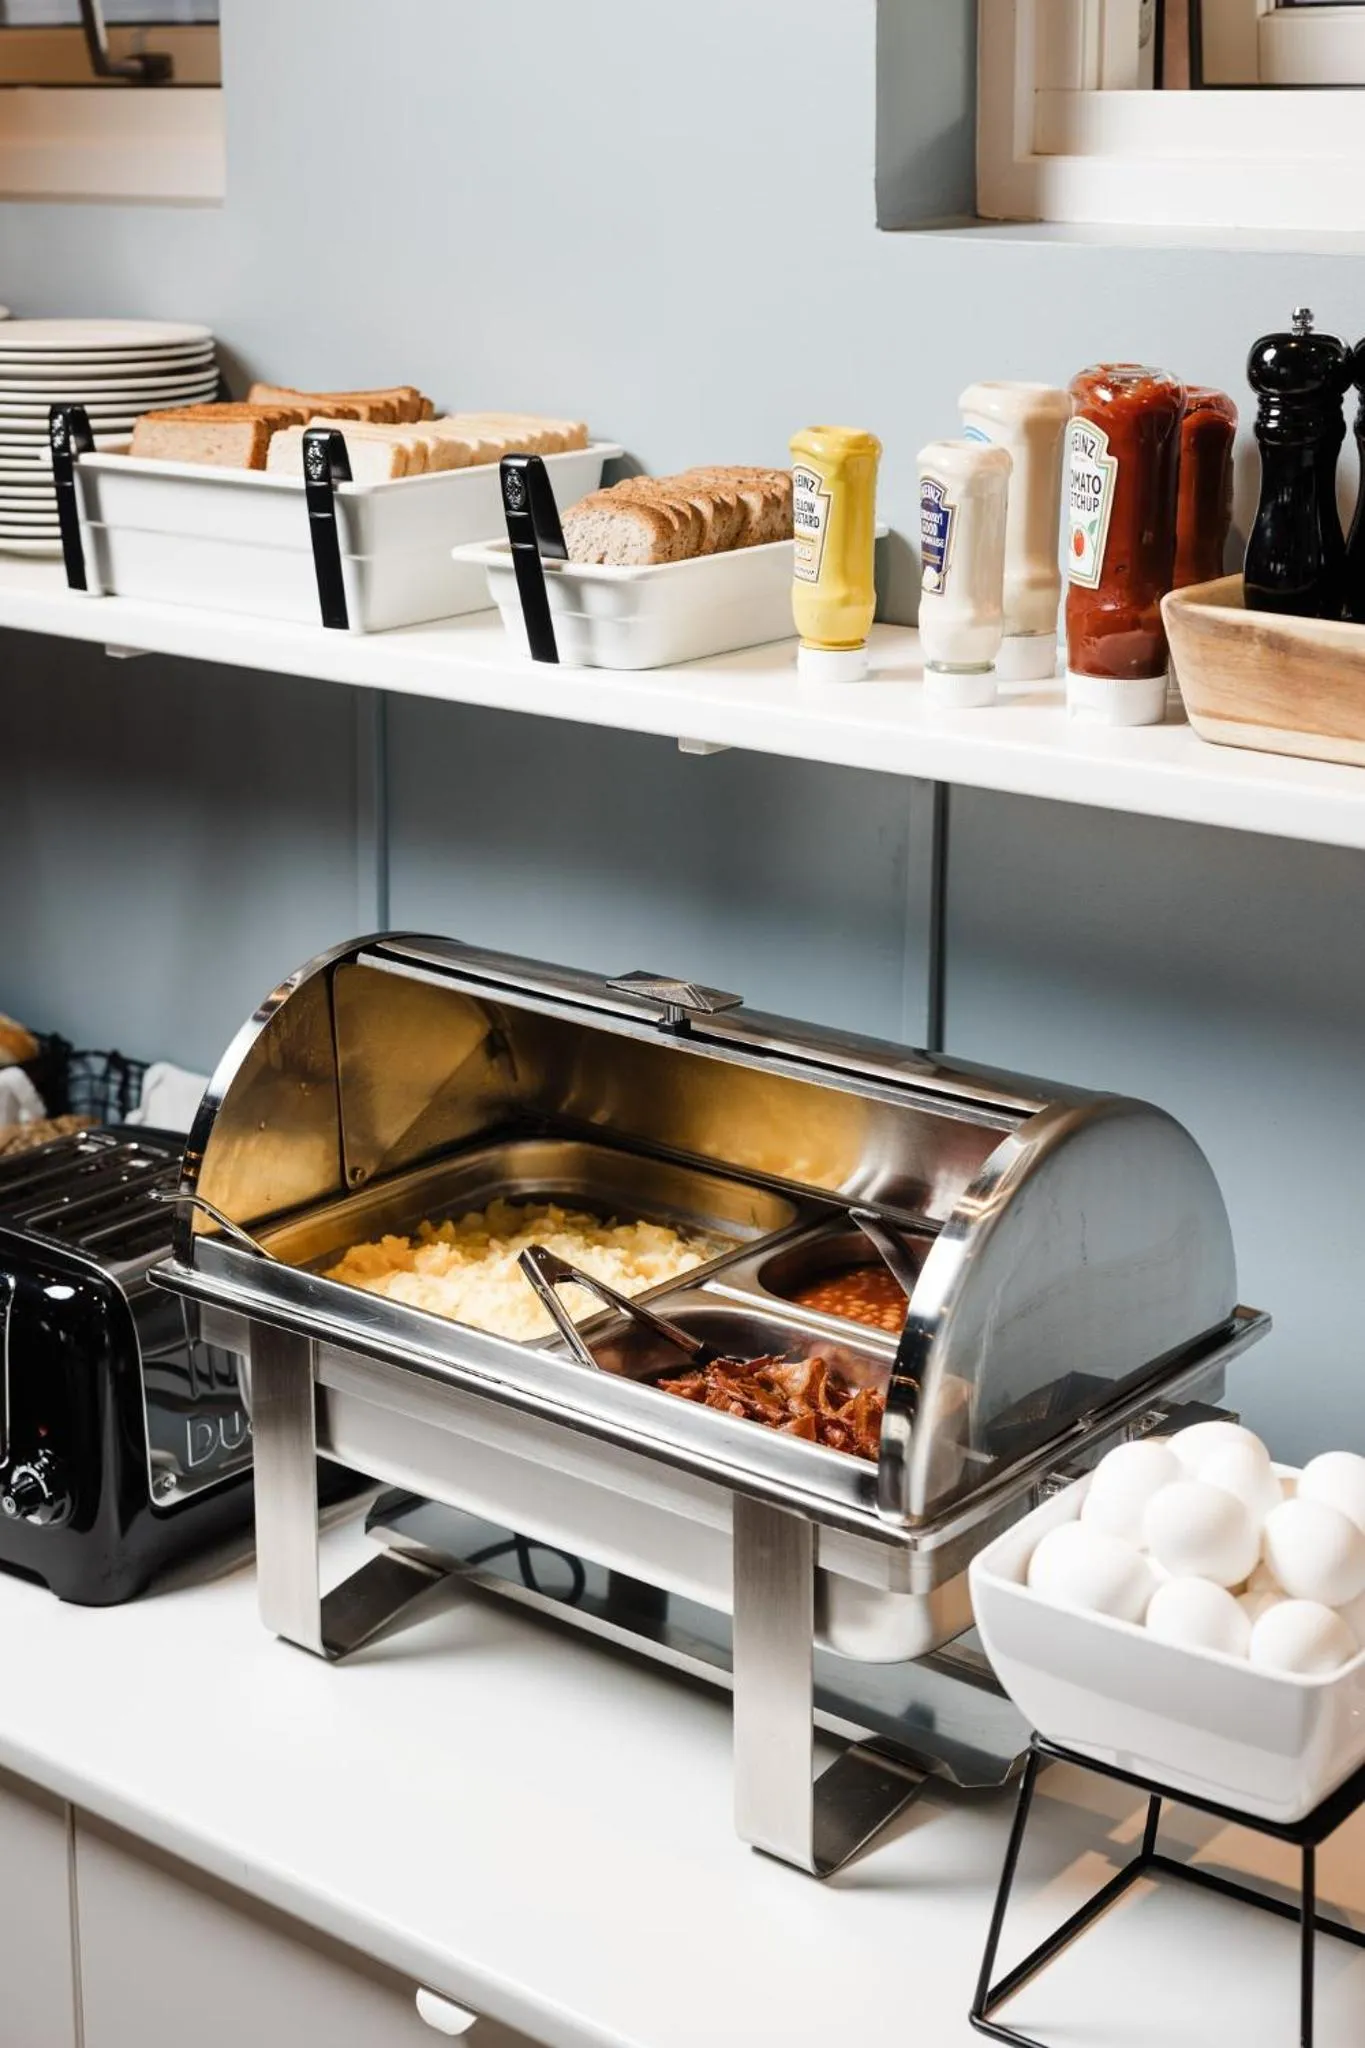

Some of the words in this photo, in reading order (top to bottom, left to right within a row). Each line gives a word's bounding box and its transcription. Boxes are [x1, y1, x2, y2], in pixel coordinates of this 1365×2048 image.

[795, 474, 815, 493] EINZ
[1070, 469, 1102, 495] OMATO
[1070, 491, 1100, 513] ETCHUP
